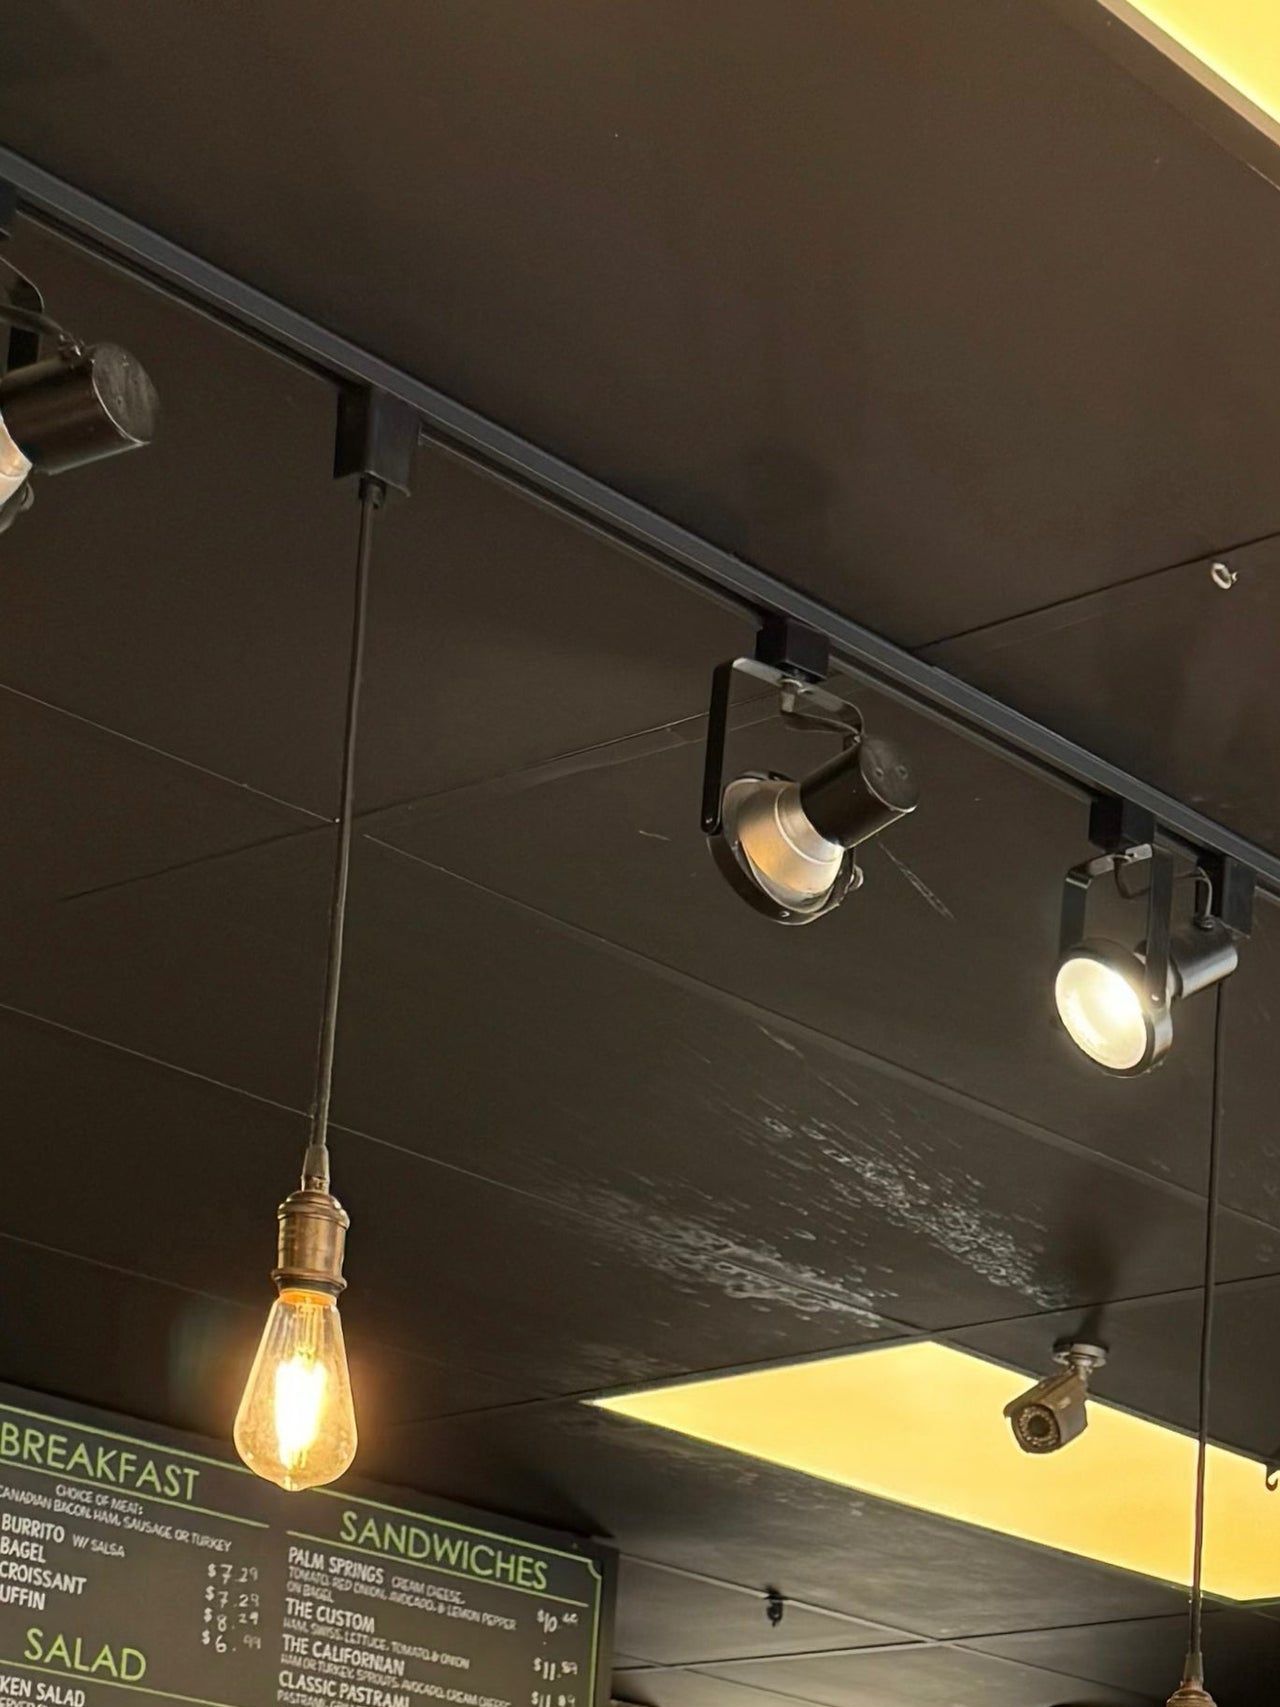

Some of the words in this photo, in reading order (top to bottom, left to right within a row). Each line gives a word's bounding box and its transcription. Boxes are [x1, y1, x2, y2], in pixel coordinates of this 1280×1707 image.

[0, 1421, 200, 1500] BREAKFAST
[56, 1484, 93, 1503] CHOICE
[96, 1494, 109, 1506] OF
[111, 1497, 144, 1516] MEAT:
[1, 1513, 66, 1544] BURRITO
[123, 1515, 173, 1541] SAUSAGE
[174, 1529, 189, 1543] OR
[191, 1533, 232, 1552] TURKEY
[0, 1536, 47, 1564] BAGEL
[288, 1546, 325, 1571] PALM
[328, 1556, 385, 1586] SPRINGS
[340, 1510, 548, 1591] SANDWICHES
[0, 1560, 88, 1596] CROISSANT
[0, 1583, 46, 1611] UFFIN
[285, 1597, 314, 1619] THE
[316, 1605, 375, 1635] CUSTOM
[24, 1627, 147, 1683] SALAD
[282, 1633, 310, 1656] THE
[312, 1640, 406, 1678] CALIFORNIAN
[36, 1682, 85, 1707] SALAD
[278, 1670, 337, 1697] CLASSIC
